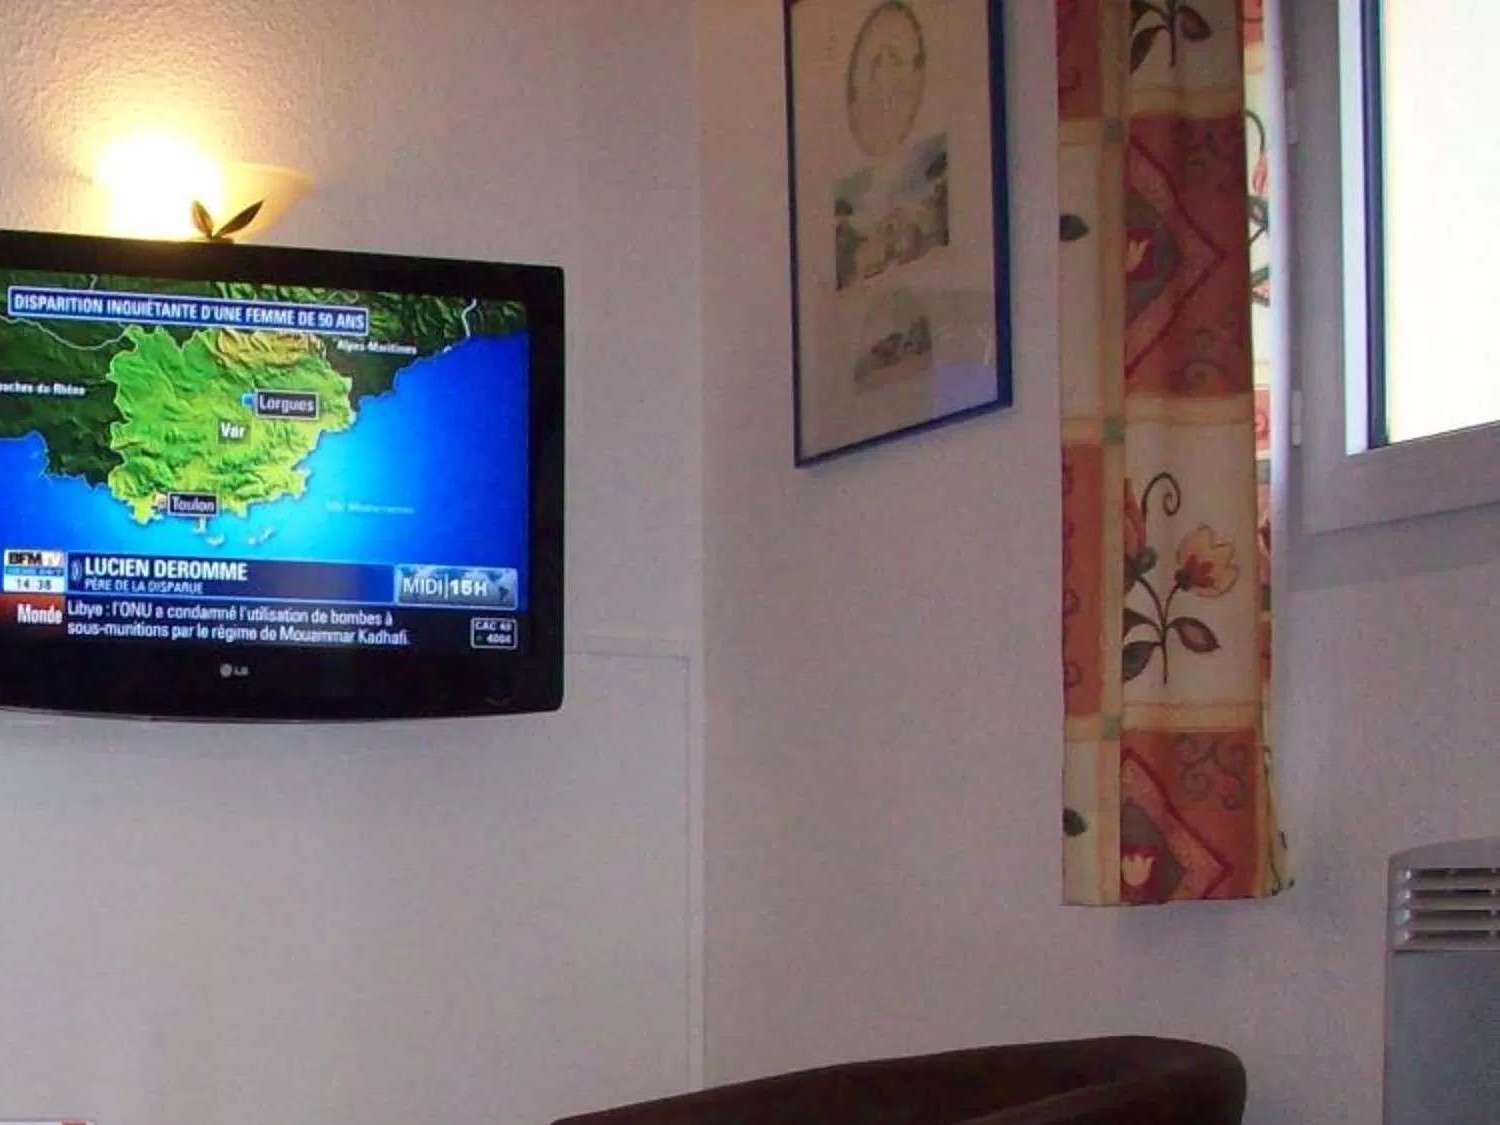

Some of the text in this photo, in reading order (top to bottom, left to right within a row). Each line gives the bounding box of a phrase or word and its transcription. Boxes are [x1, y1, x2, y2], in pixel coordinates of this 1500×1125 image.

[14, 294, 104, 313] DISPARITION
[201, 305, 242, 322] D'UNE
[245, 307, 296, 325] FEMME
[299, 311, 316, 327] DE
[318, 312, 334, 328] 50
[335, 314, 365, 329] ANS
[259, 395, 315, 413] Lorgues
[220, 421, 245, 438] Var
[172, 496, 215, 512] Toulon
[85, 557, 249, 581] LUCIEN DEROMME
[114, 580, 129, 592] DE
[132, 581, 147, 592] LA
[148, 581, 203, 594] DISPARUE
[17, 603, 63, 624] Monde
[67, 600, 103, 619] Libye
[111, 601, 152, 618] l'ONU
[155, 606, 165, 619] a
[167, 605, 237, 621] condamné
[239, 604, 308, 623] l'utilisation
[311, 608, 328, 624] de
[330, 609, 383, 626] bombes
[384, 610, 393, 627] à
[67, 621, 169, 638] sous-munitions
[172, 625, 195, 640] par
[196, 623, 209, 638] le
[211, 625, 257, 643] régime
[259, 625, 277, 641] de
[279, 626, 356, 643] Mouammar
